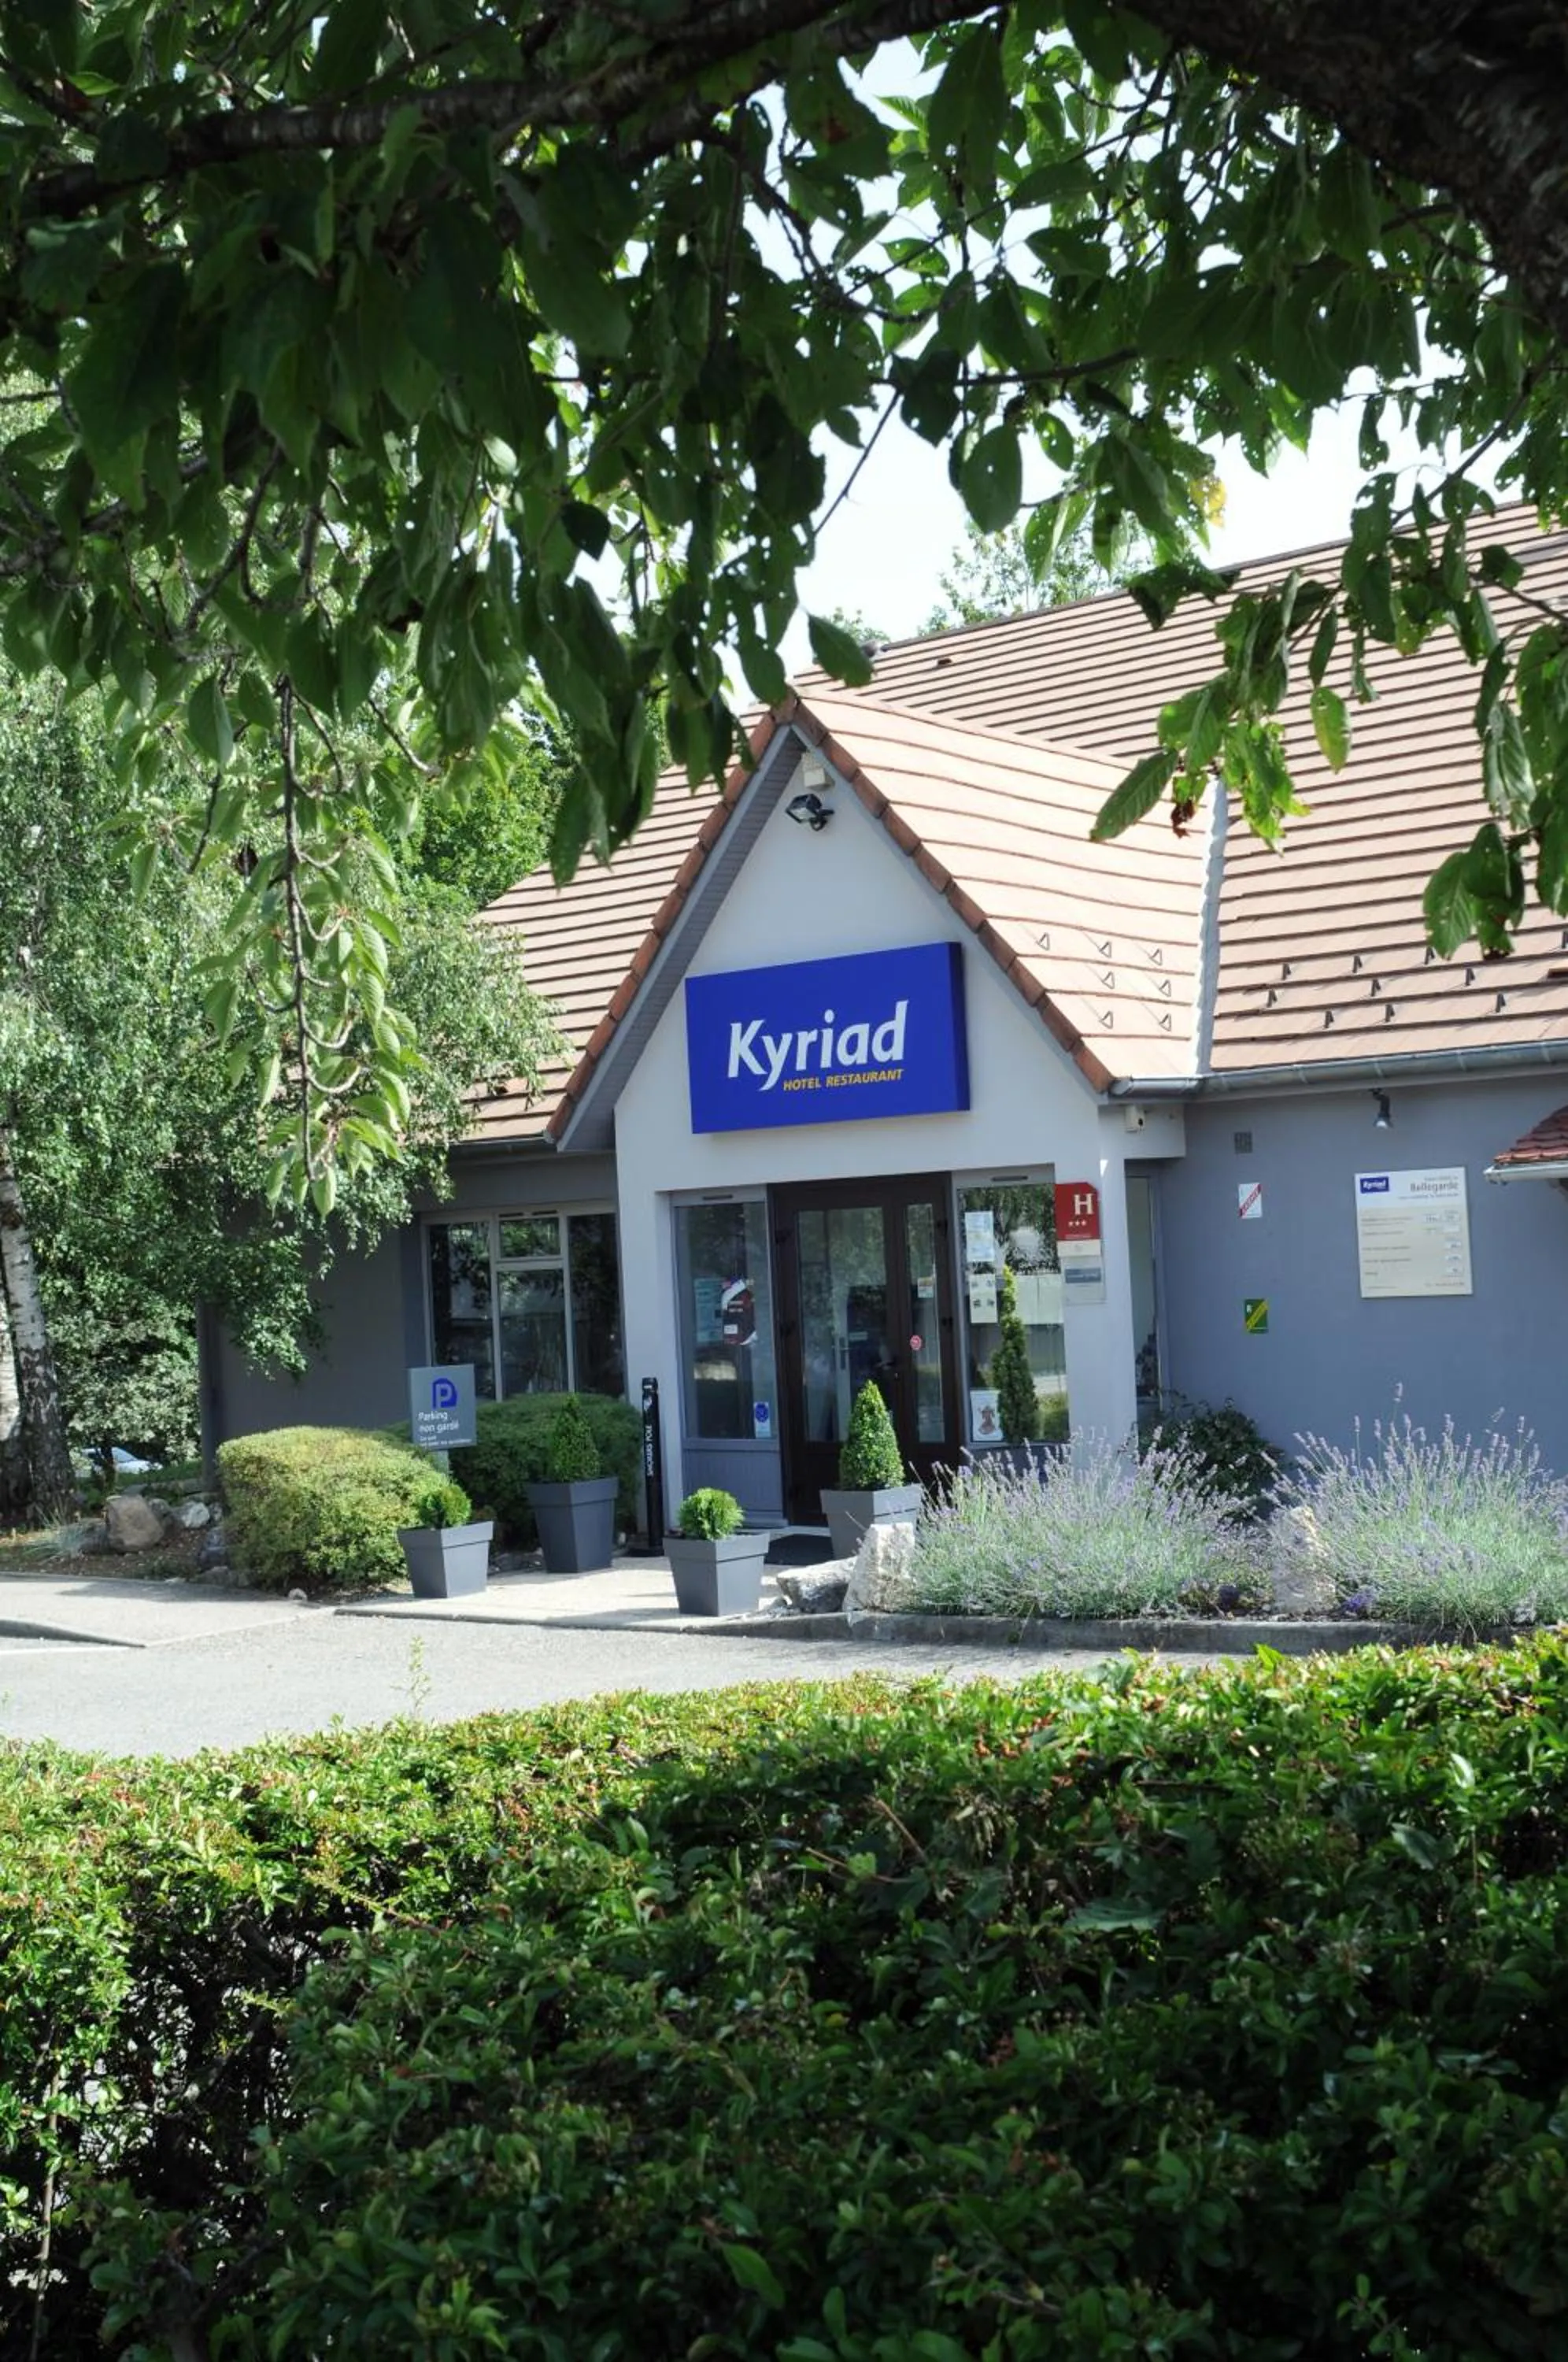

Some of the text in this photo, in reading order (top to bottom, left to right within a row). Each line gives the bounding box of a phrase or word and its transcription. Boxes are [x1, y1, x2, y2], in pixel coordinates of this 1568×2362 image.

[727, 1000, 908, 1091] Kyriad
[783, 1068, 904, 1091] HOTEL RESTAURANT
[1074, 1194, 1093, 1215] H
[418, 1411, 447, 1421] Parking
